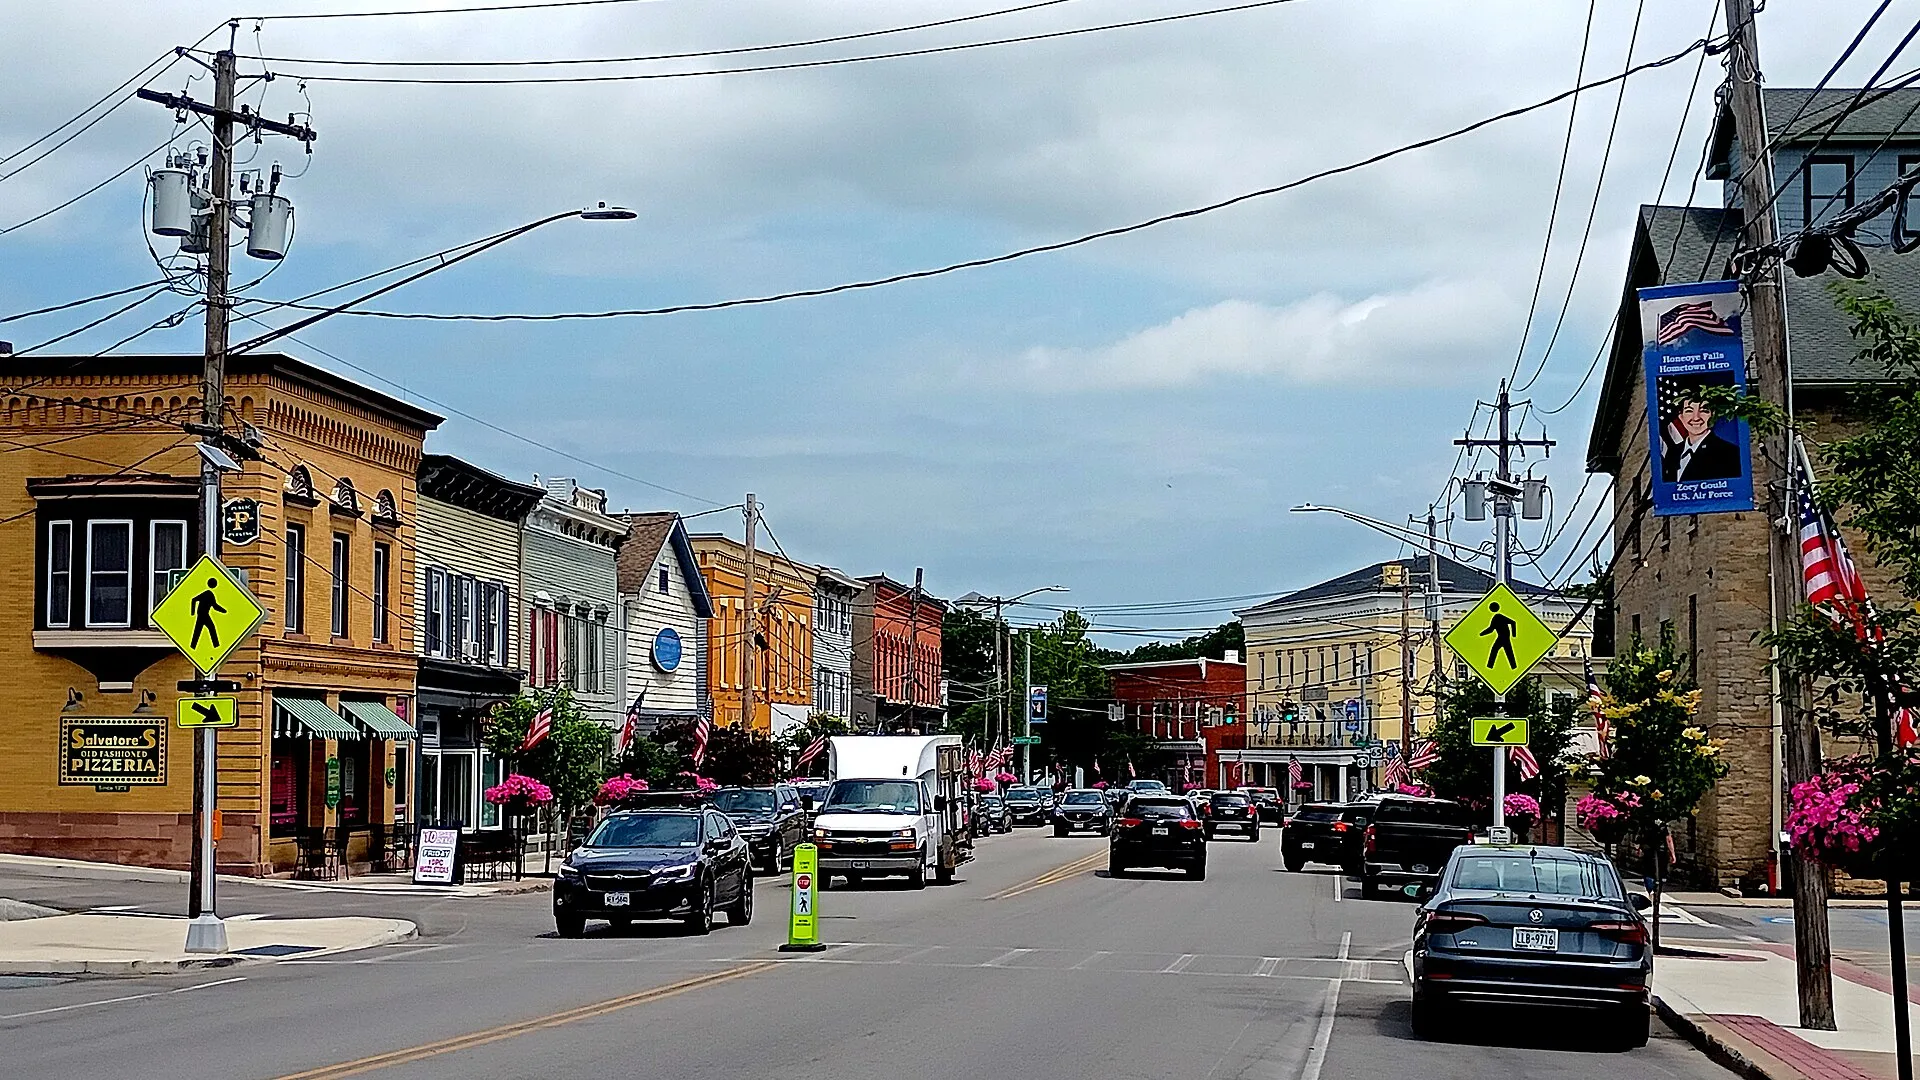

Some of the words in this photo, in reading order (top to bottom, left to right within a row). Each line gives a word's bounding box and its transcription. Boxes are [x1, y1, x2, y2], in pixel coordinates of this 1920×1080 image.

[1662, 355, 1701, 364] Honeoye
[1703, 352, 1725, 360] Falls
[1659, 364, 1706, 373] Hometown
[1708, 361, 1730, 370] Hero
[1676, 483, 1699, 492] Zoey
[1700, 481, 1728, 489] Gould
[1672, 493, 1690, 501] U.S.
[1692, 491, 1706, 499] Air
[1708, 490, 1734, 499] Force
[232, 511, 250, 531] P
[80, 750, 98, 758] OLD
[99, 750, 148, 758] FASHIONED
[71, 758, 157, 772] PIZZERIA
[422, 848, 450, 858] FRIDAY
[1516, 932, 1554, 946] LLB-9716
